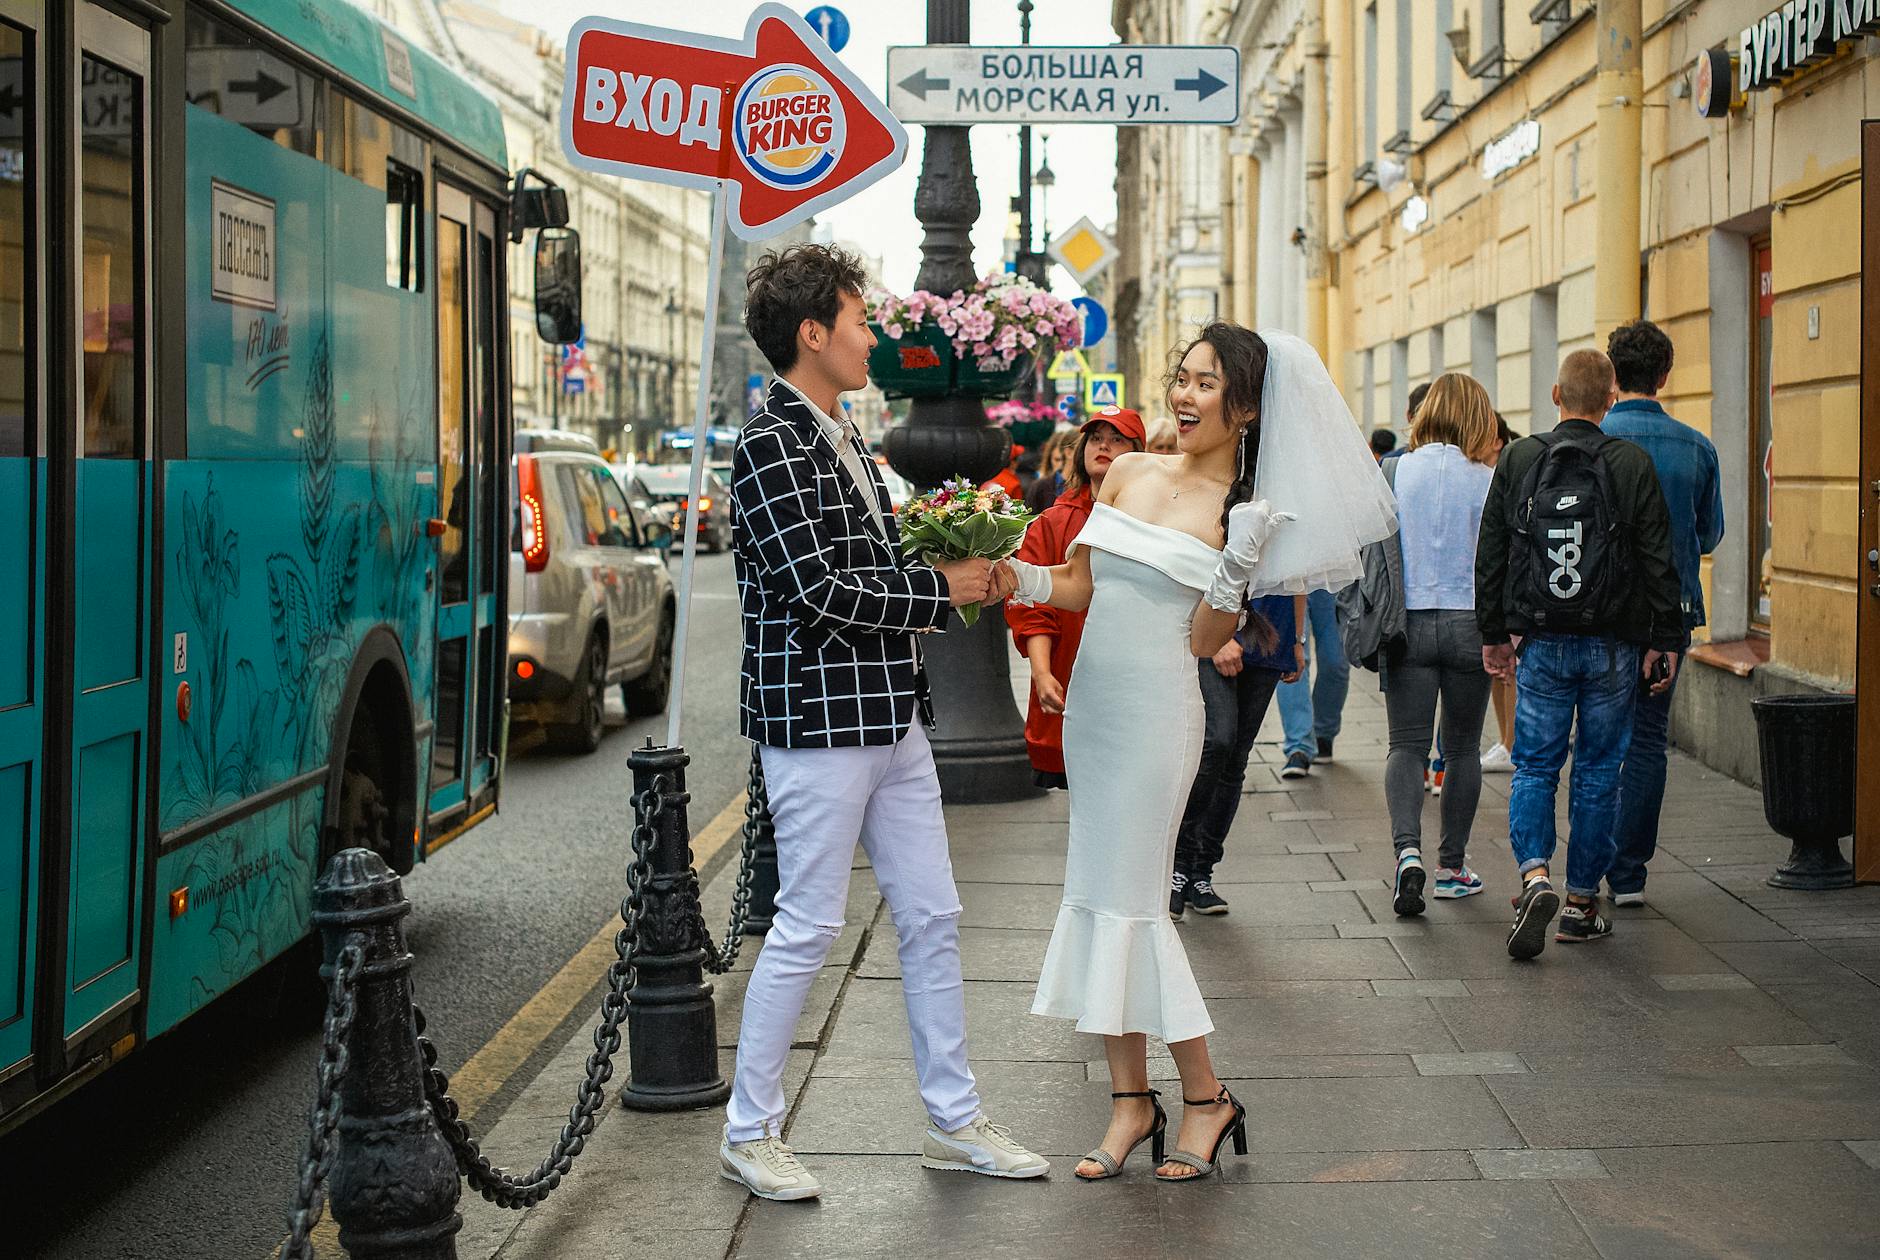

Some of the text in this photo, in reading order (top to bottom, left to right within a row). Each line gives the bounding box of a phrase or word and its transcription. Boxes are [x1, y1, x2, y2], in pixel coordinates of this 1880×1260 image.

[981, 54, 1143, 80] БОЛЬШАЯ
[1740, 0, 1826, 93] БУРГЕР
[582, 66, 722, 151] ВХОД
[746, 94, 831, 126] BURGER
[955, 87, 1170, 118] МОРСКАЯ ул.
[746, 115, 833, 157] KING
[246, 317, 266, 365] 170
